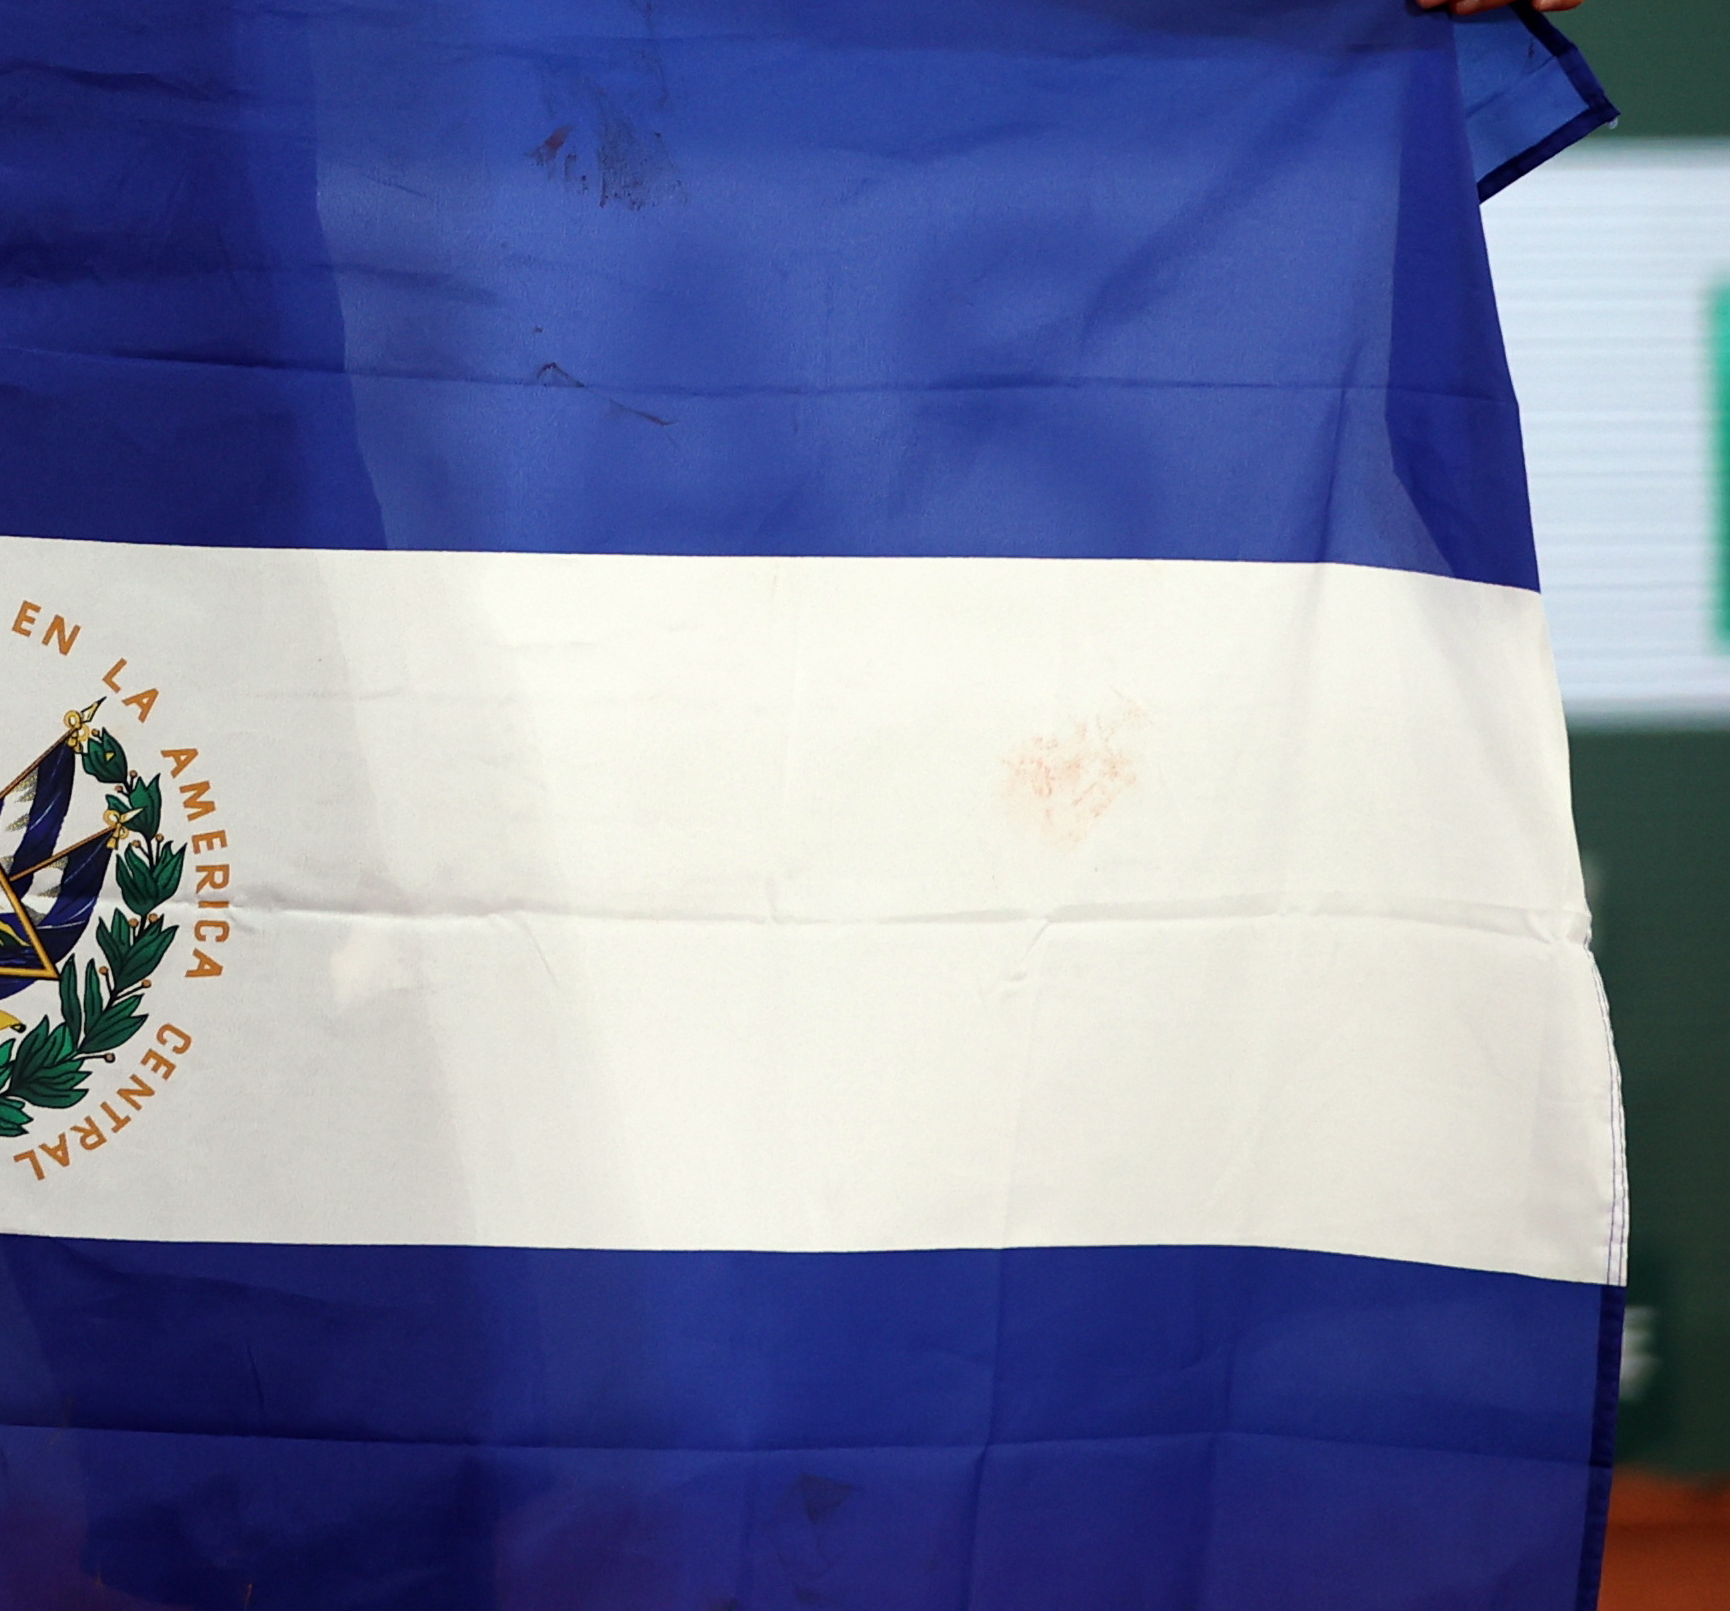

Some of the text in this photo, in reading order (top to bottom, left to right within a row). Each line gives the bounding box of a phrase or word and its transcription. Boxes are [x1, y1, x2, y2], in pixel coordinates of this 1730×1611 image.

[11, 600, 81, 656] EN
[102, 658, 159, 723] LA
[160, 748, 230, 978] AMERICA
[13, 1023, 193, 1181] CENTRAL
